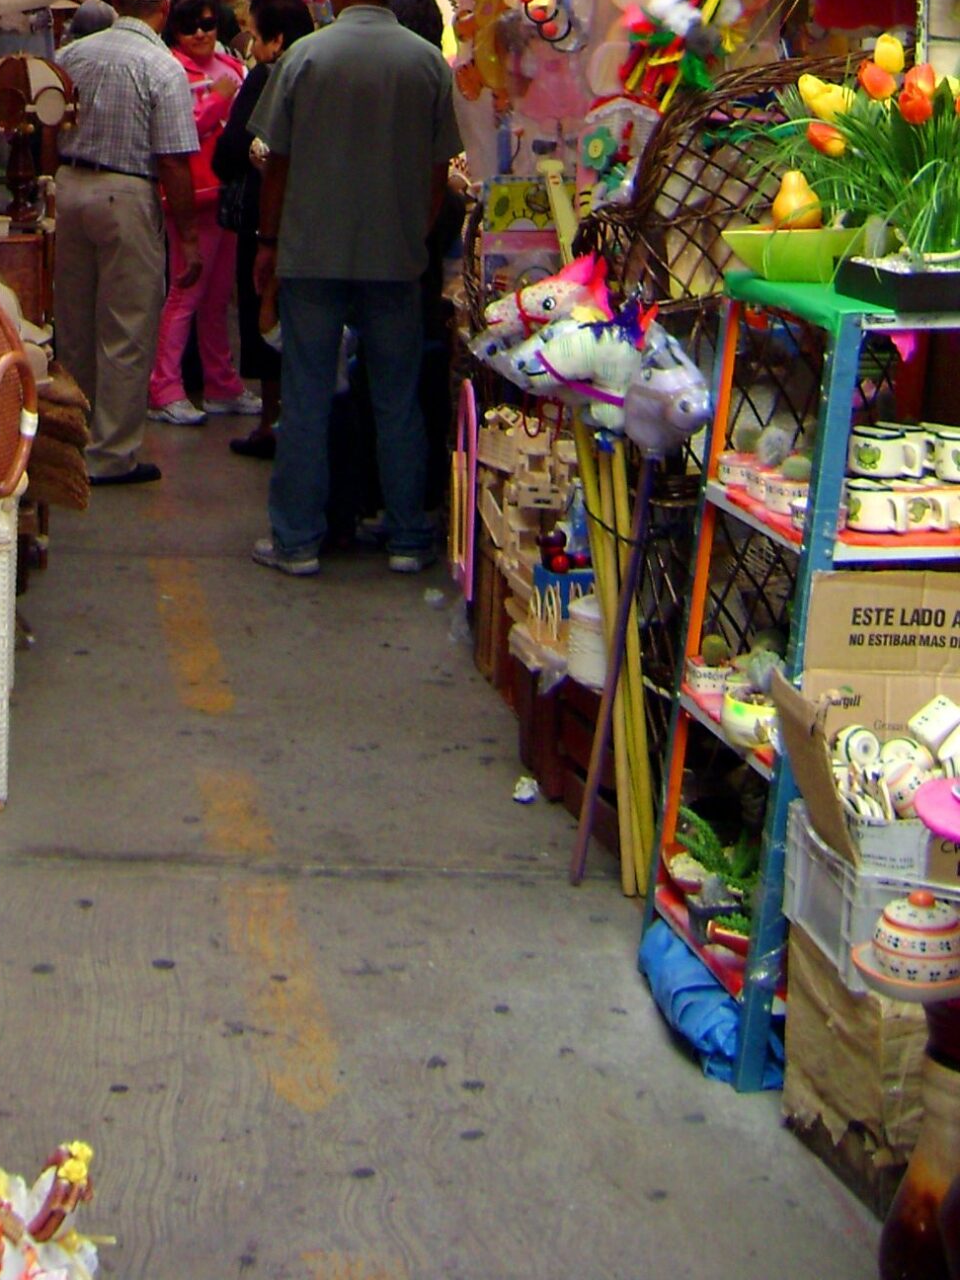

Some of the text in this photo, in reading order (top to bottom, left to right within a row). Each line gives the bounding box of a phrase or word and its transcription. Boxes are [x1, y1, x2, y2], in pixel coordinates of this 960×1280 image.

[851, 607, 894, 626] ESTE
[900, 608, 946, 628] LADO
[848, 633, 960, 649] NO ESTIBAR MAS D
